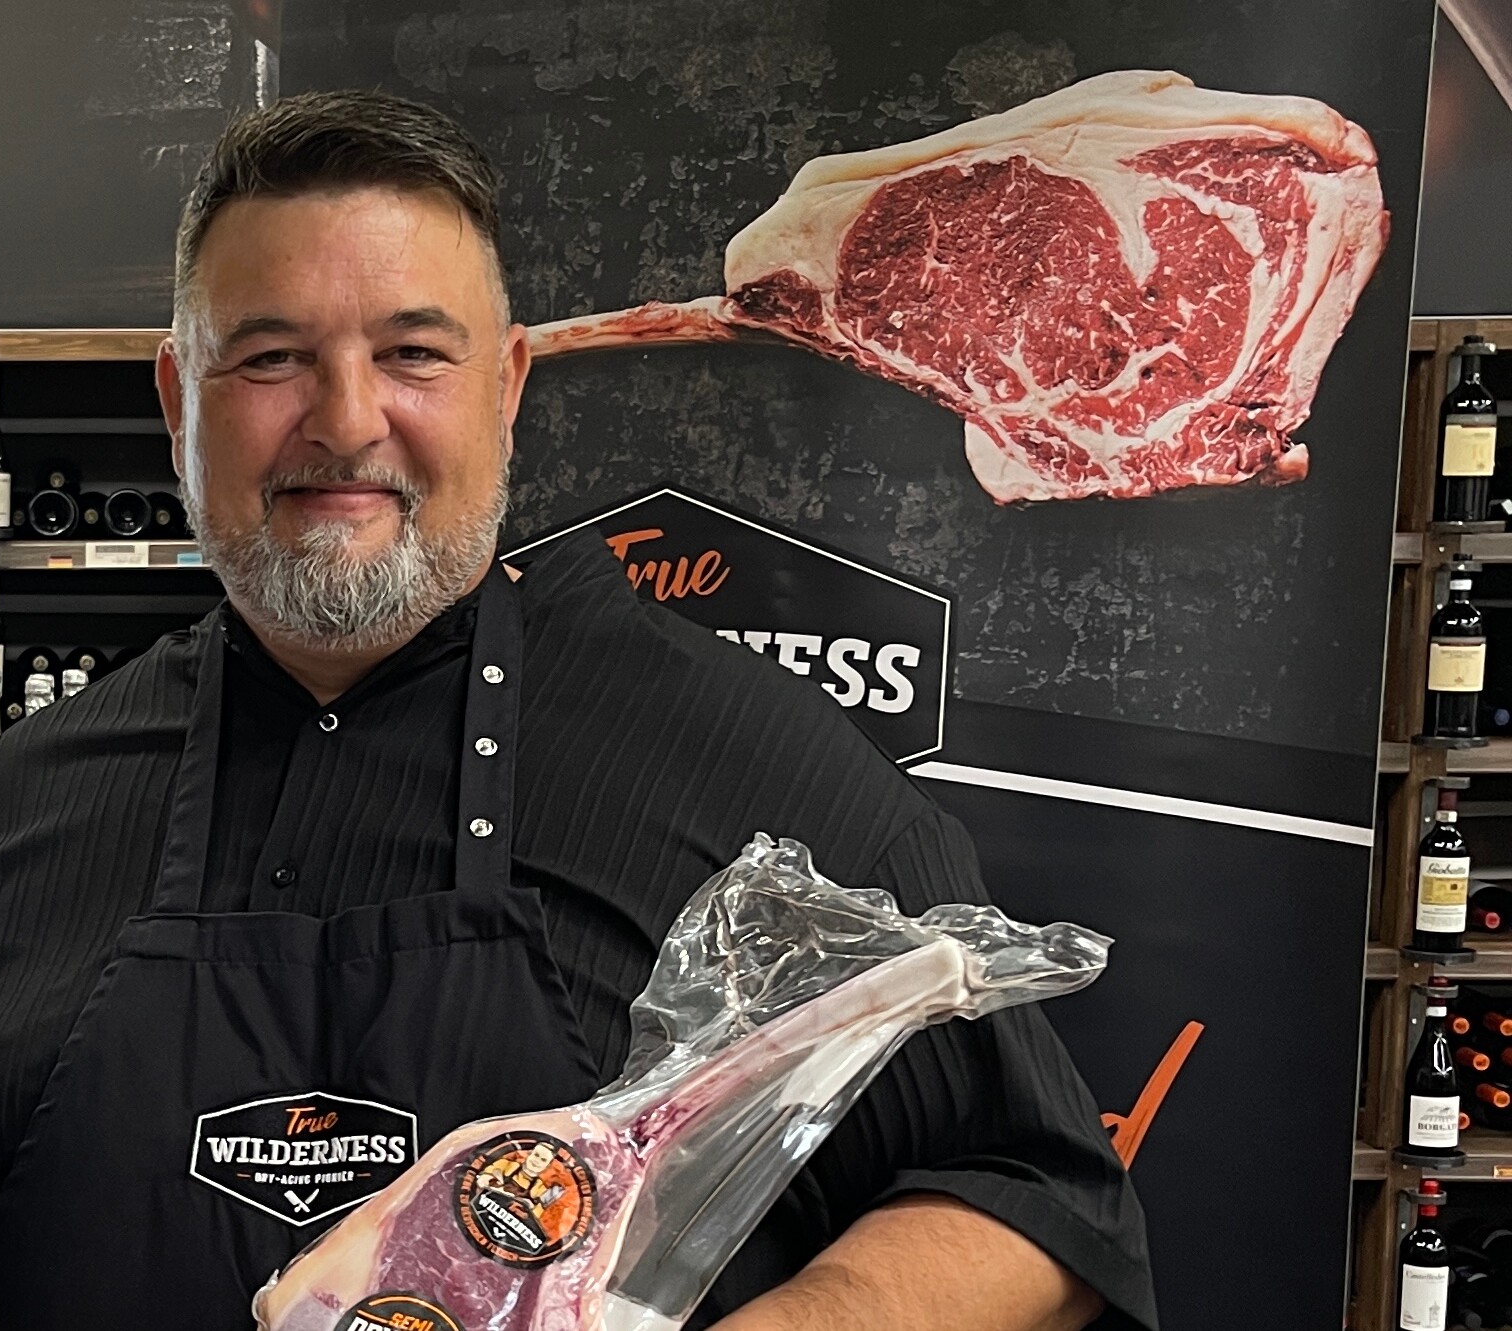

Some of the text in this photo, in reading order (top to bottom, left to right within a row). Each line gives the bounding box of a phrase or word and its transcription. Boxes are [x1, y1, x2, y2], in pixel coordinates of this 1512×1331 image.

[285, 1106, 338, 1136] True
[206, 1134, 406, 1166] WILDERNESS
[478, 1193, 543, 1250] WILDERNESS
[390, 1312, 434, 1331] SEMI
